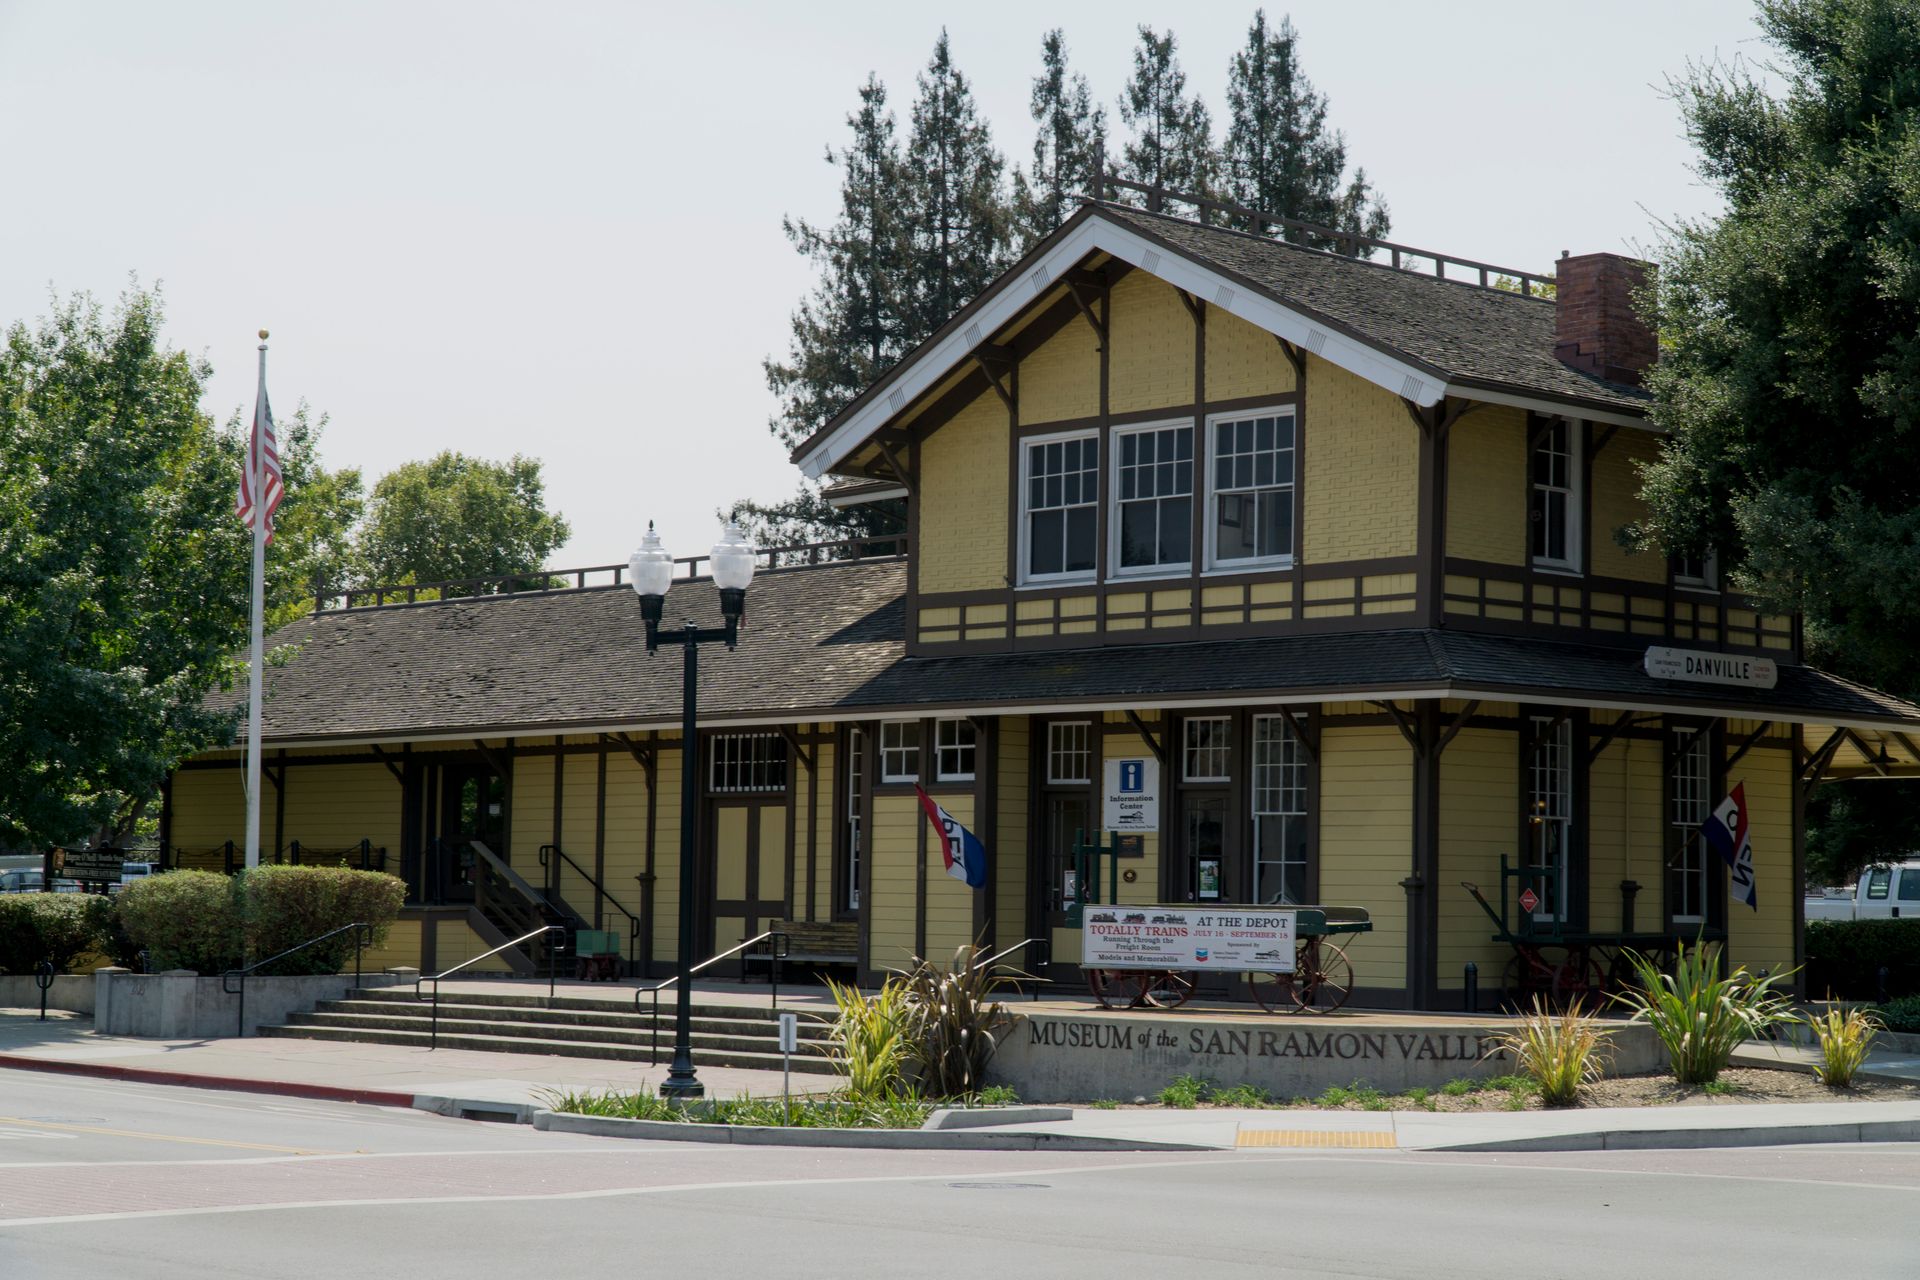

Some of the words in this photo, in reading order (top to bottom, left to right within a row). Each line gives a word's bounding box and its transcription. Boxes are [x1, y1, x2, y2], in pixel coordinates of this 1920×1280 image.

[1686, 656, 1750, 679] DANVILLE
[1197, 917, 1213, 926] AT
[1217, 917, 1242, 927] THE
[1246, 918, 1288, 928] DEPOT
[1090, 925, 1142, 935] TOTALLY
[1145, 926, 1188, 936] TRAINS
[1230, 931, 1277, 939] SEPTEMBER
[1030, 1020, 1133, 1050] MUSEUM
[1138, 1028, 1151, 1047] of
[1156, 1029, 1179, 1047] the
[1188, 1028, 1249, 1056] SAN
[1257, 1031, 1386, 1060] RAMON
